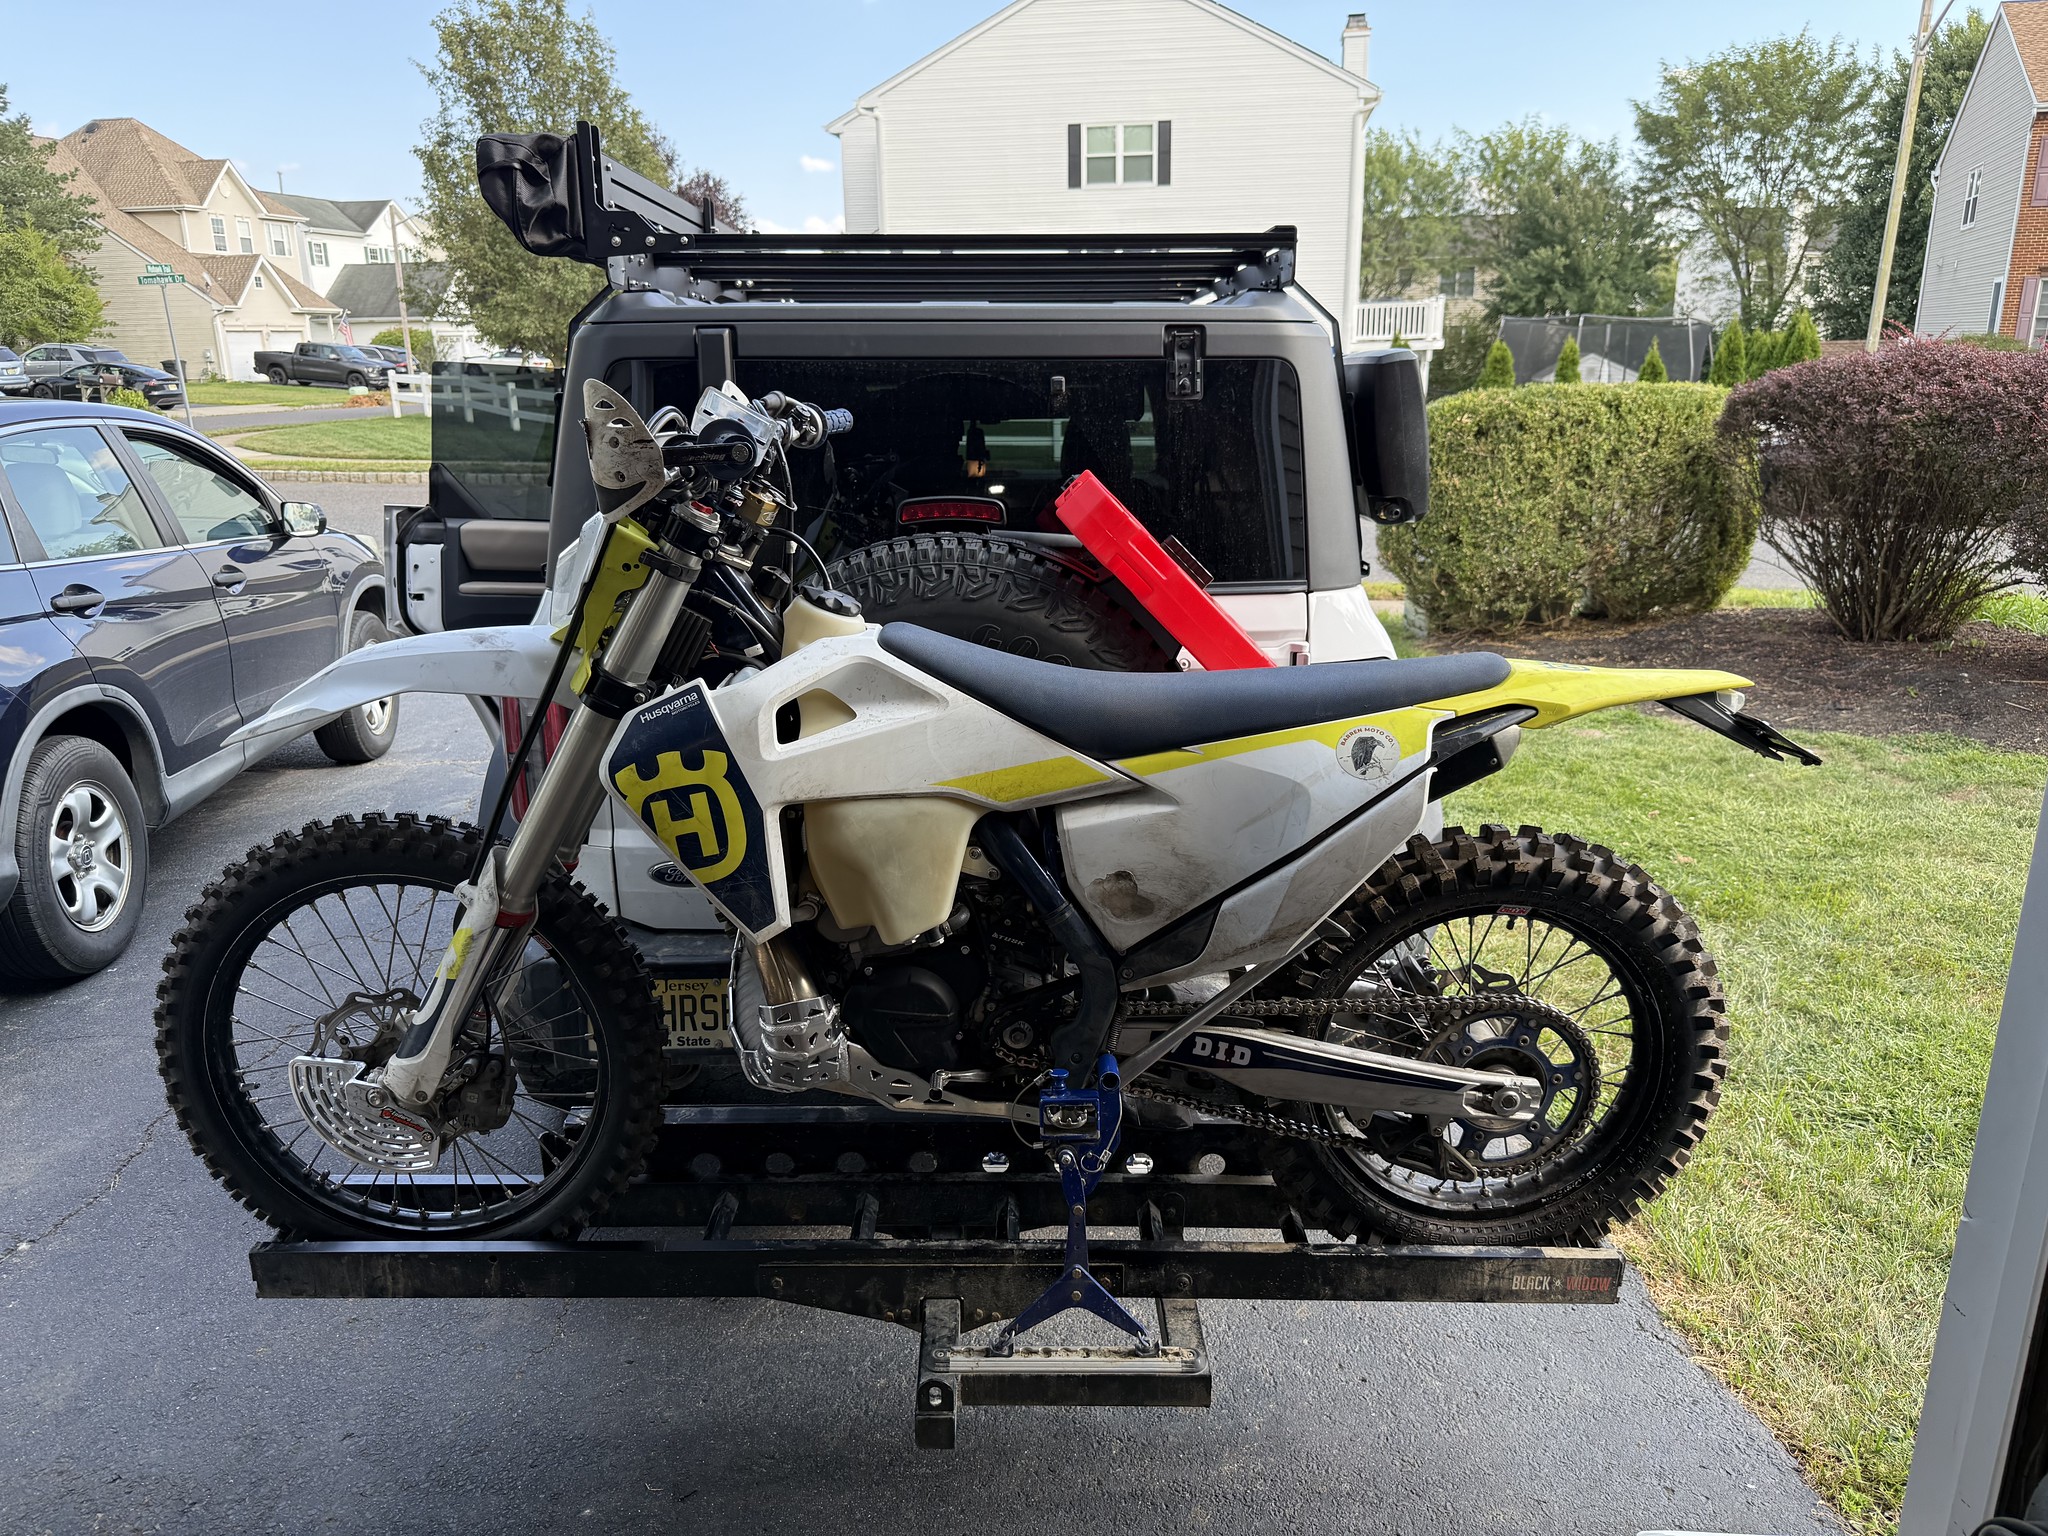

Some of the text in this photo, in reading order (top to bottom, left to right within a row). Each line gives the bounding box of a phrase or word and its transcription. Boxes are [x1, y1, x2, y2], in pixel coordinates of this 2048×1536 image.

[140, 275, 183, 285] Tomahawk Dr
[640, 691, 699, 724] Husqvarna
[1340, 728, 1363, 747] BARREN
[1364, 727, 1385, 736] MOTO
[998, 934, 1027, 946] TUSK
[662, 979, 709, 993] Jersey
[677, 1036, 711, 1047] State
[1511, 1275, 1614, 1292] BLACK WIDOW
